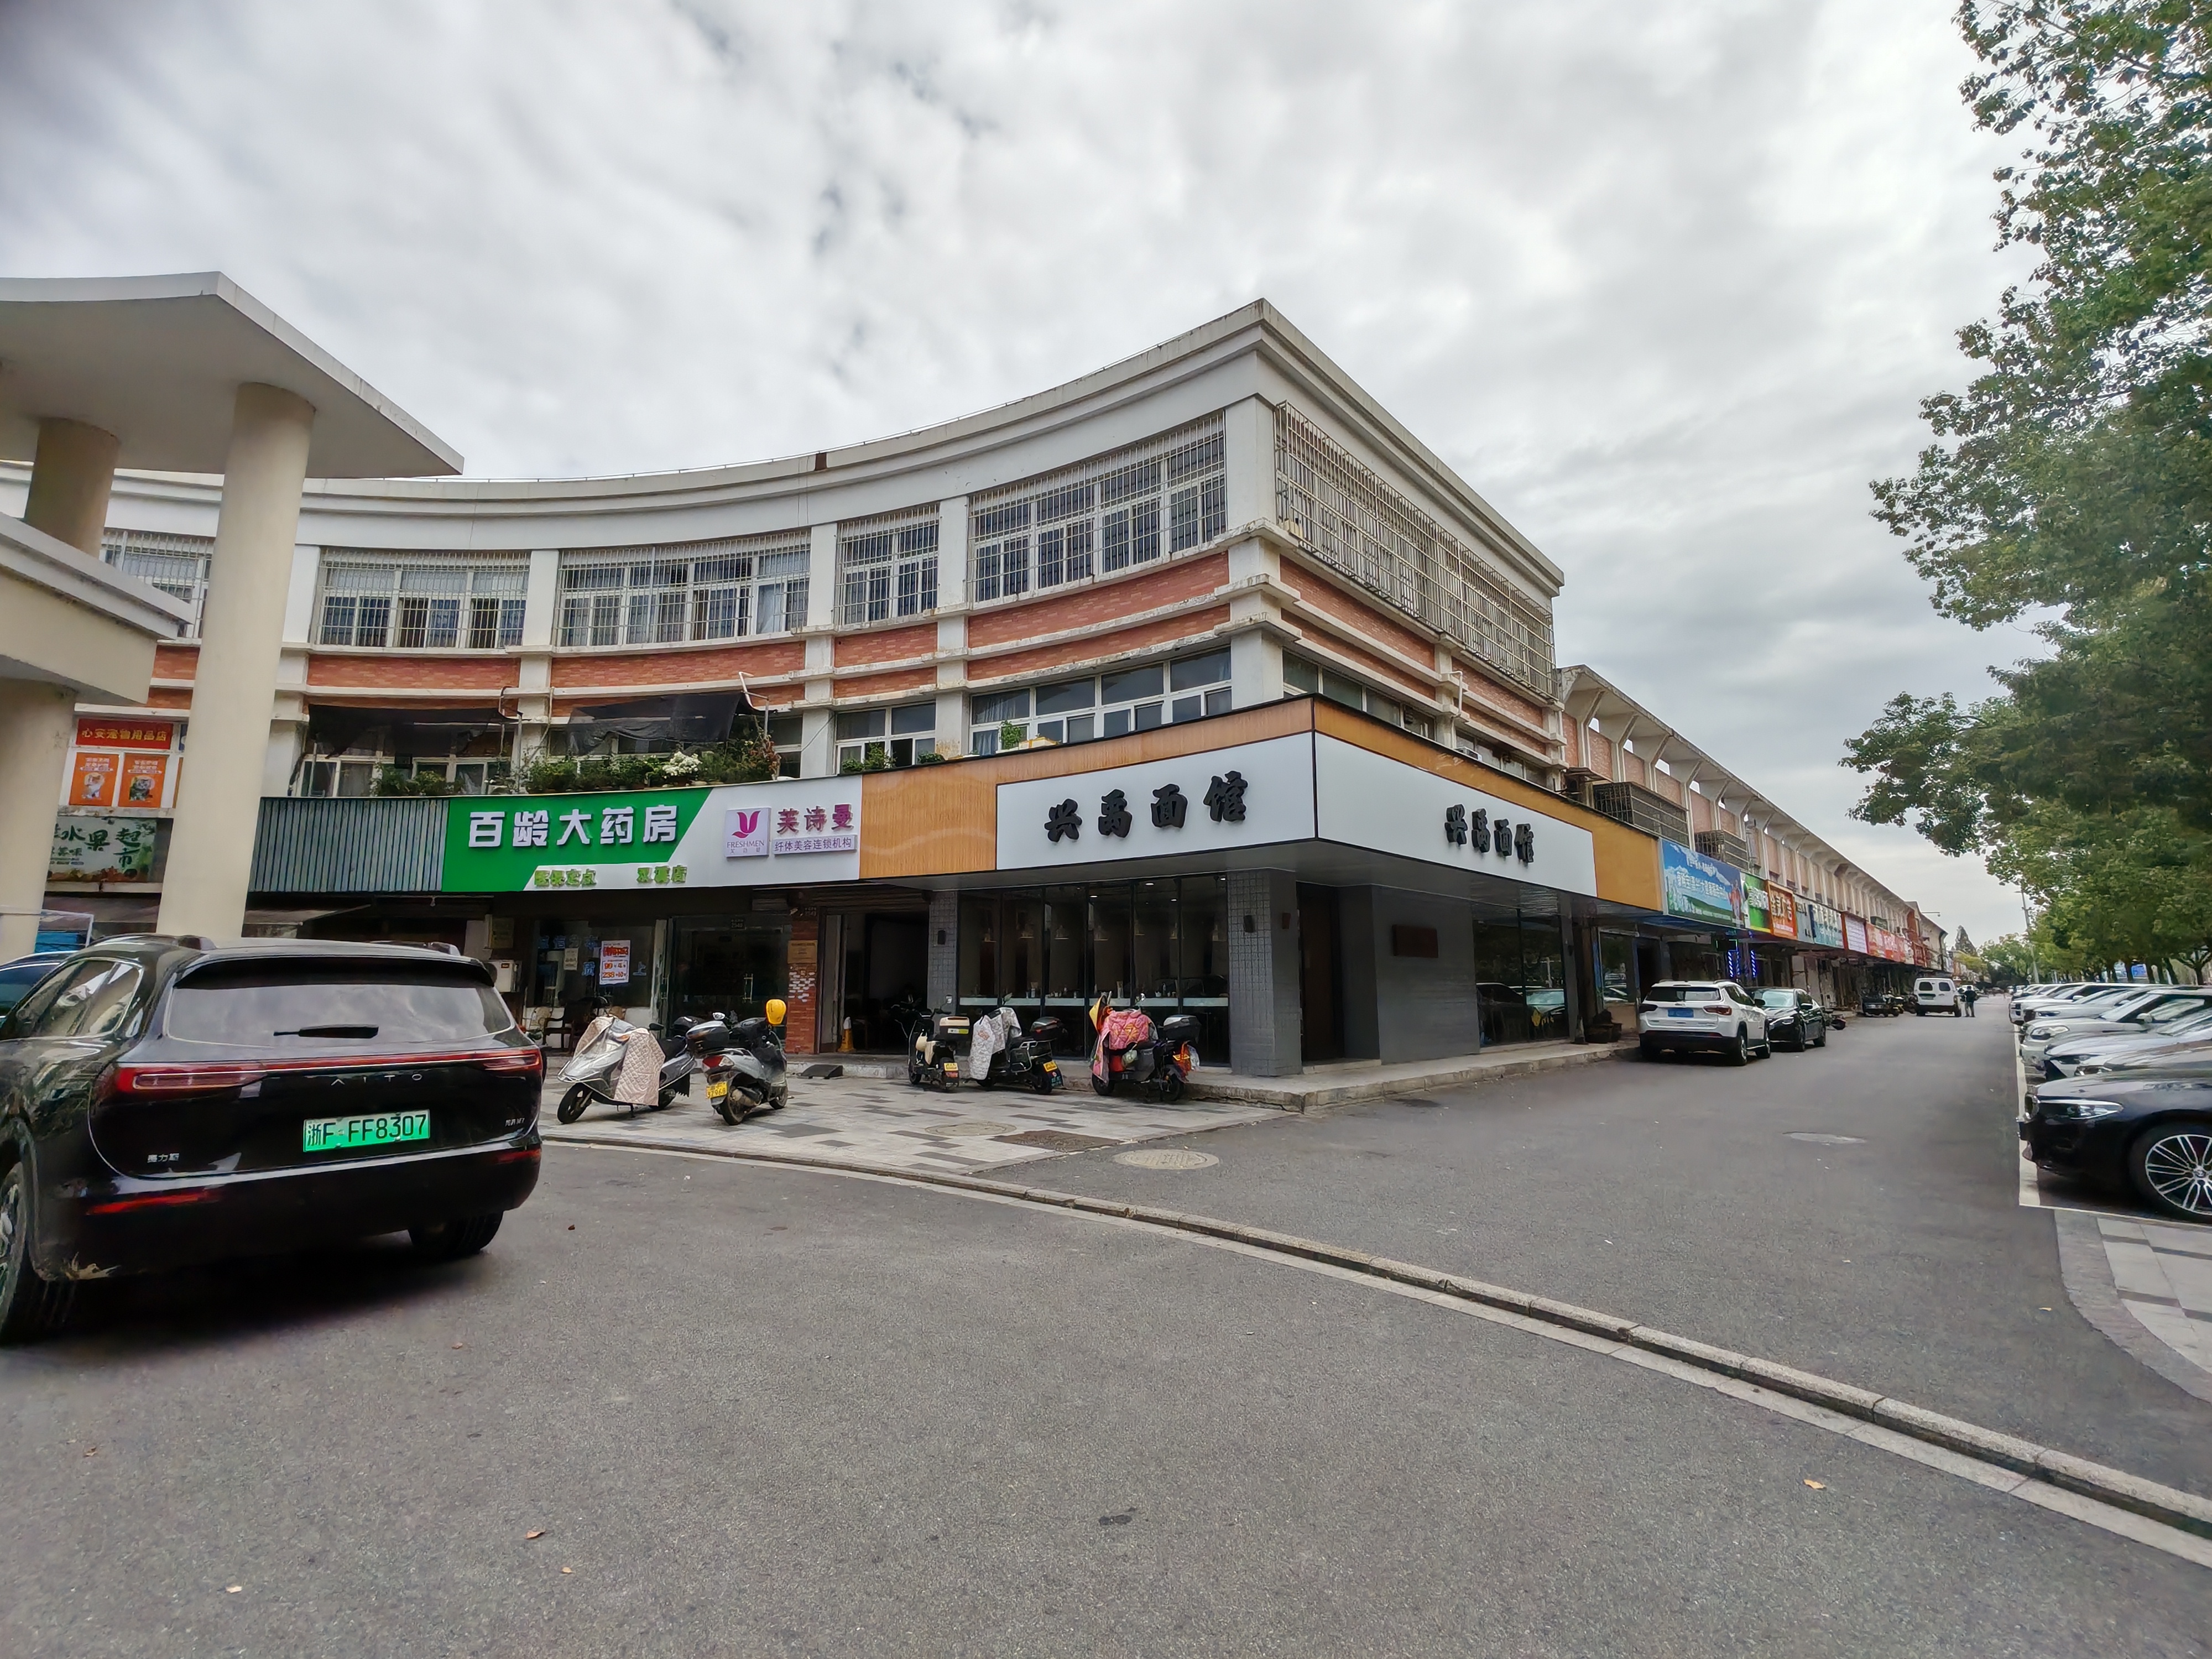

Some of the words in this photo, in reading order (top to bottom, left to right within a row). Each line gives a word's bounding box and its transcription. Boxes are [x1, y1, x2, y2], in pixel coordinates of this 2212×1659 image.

[777, 804, 854, 834] 芙诗曼
[1044, 770, 1248, 842] 兴禹面馆
[468, 805, 677, 847] 百龄大药房
[774, 838, 852, 852] 纤体美容连锁机构
[331, 1073, 422, 1086] AITO
